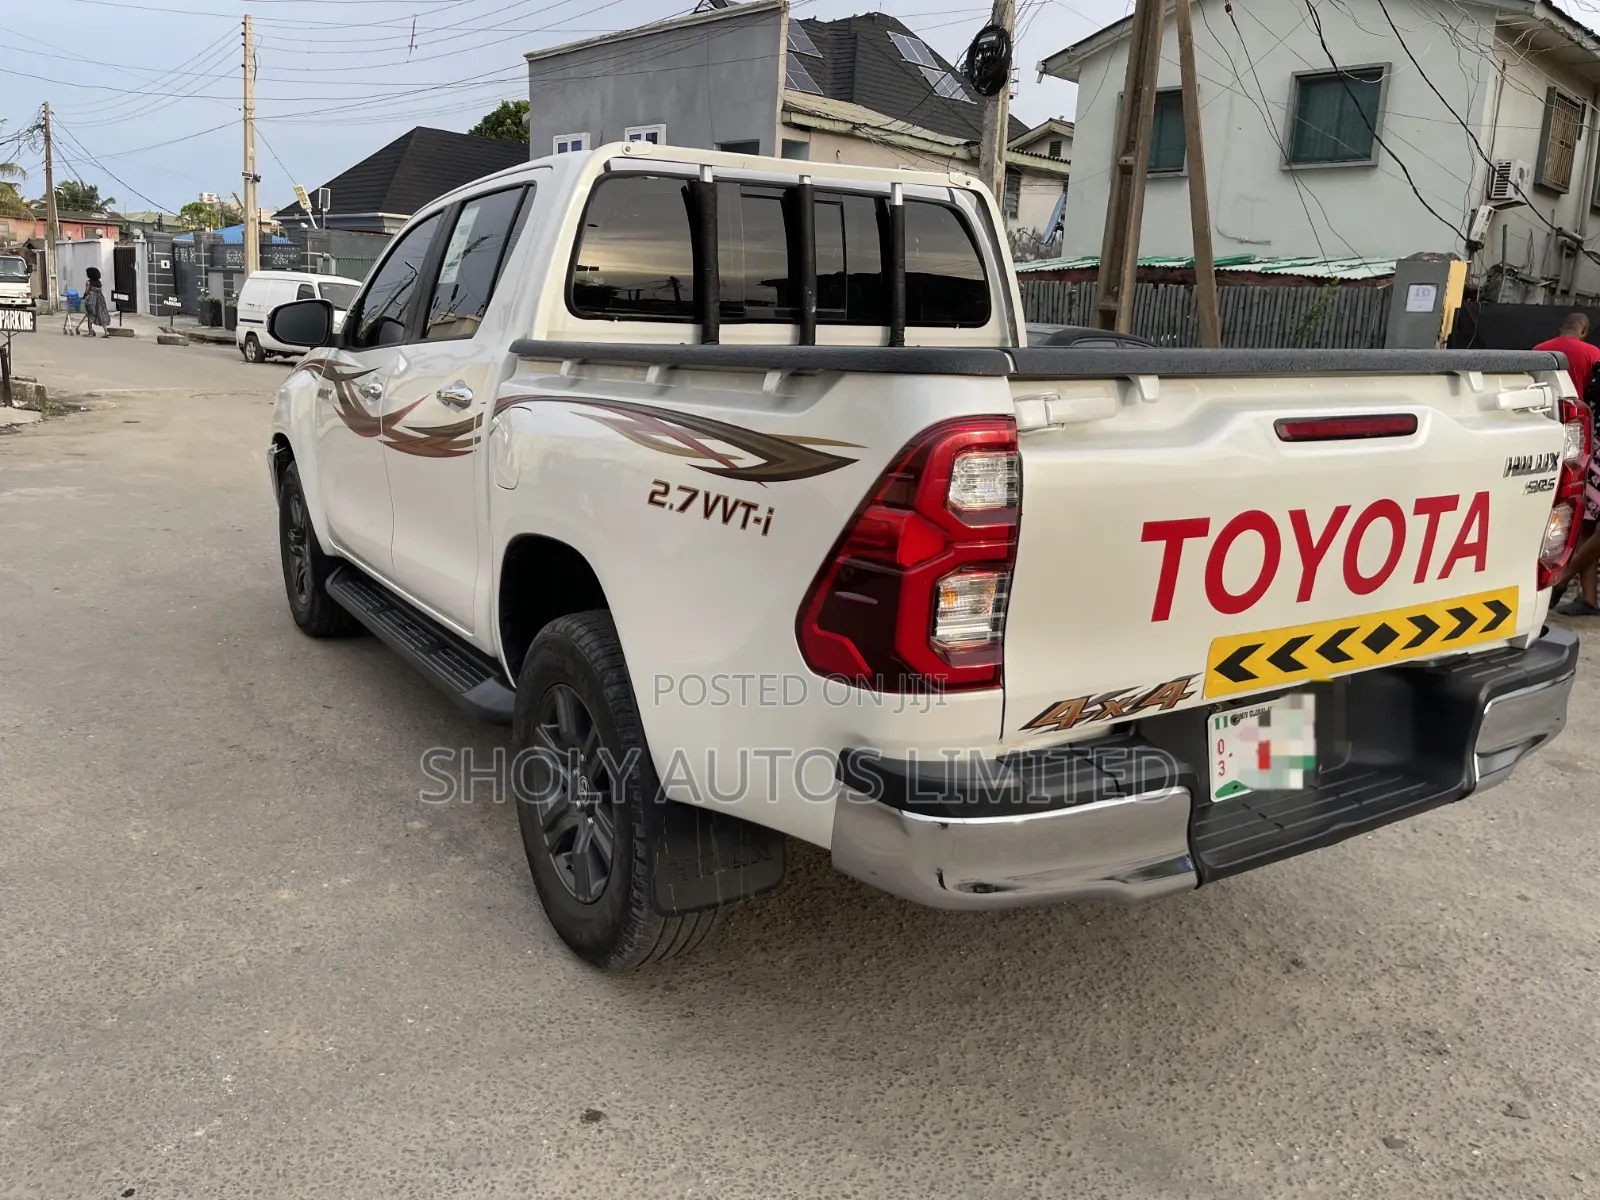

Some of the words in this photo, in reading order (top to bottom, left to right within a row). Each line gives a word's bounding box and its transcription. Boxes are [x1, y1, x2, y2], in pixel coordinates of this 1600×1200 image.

[0, 310, 33, 330] PARKING
[1503, 451, 1560, 477] HILUX
[1141, 491, 1489, 622] TOYOTA
